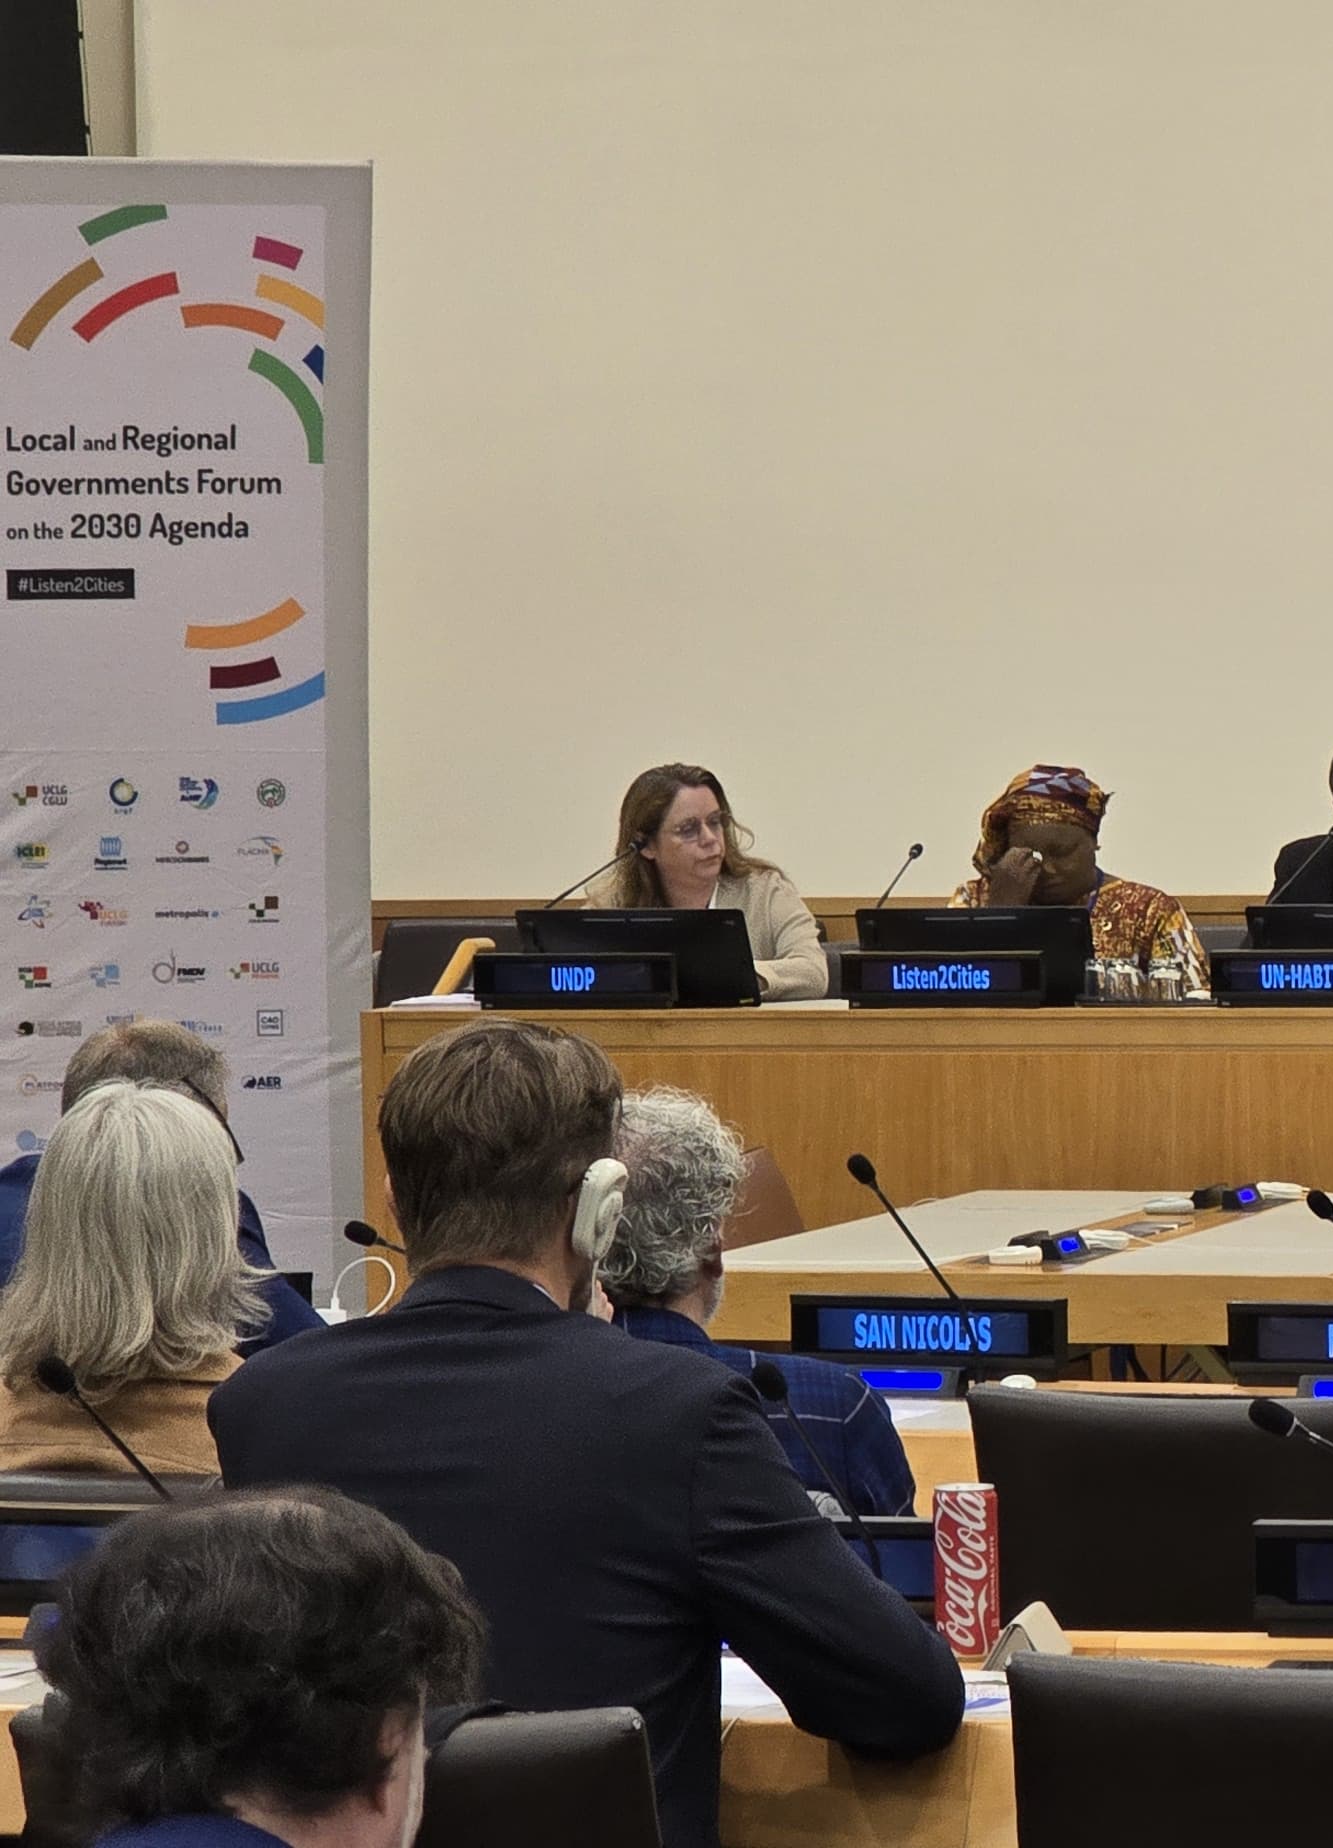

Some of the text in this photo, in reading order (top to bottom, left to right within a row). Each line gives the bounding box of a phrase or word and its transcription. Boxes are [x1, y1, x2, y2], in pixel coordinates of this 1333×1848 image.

[6, 424, 237, 457] Local and Regional
[6, 469, 282, 496] Governments Forum
[6, 512, 249, 545] on the 2030 Agenda
[18, 577, 125, 593] #Listen2Cities
[42, 785, 68, 795] UCLG
[155, 908, 209, 919] metropolis
[252, 962, 279, 973] UCLG
[551, 966, 595, 992] UNDP
[892, 965, 990, 990] Listen2Cities
[257, 1076, 281, 1087] AER
[854, 1313, 896, 1349] SAN
[935, 1491, 988, 1648] oca-Cola
